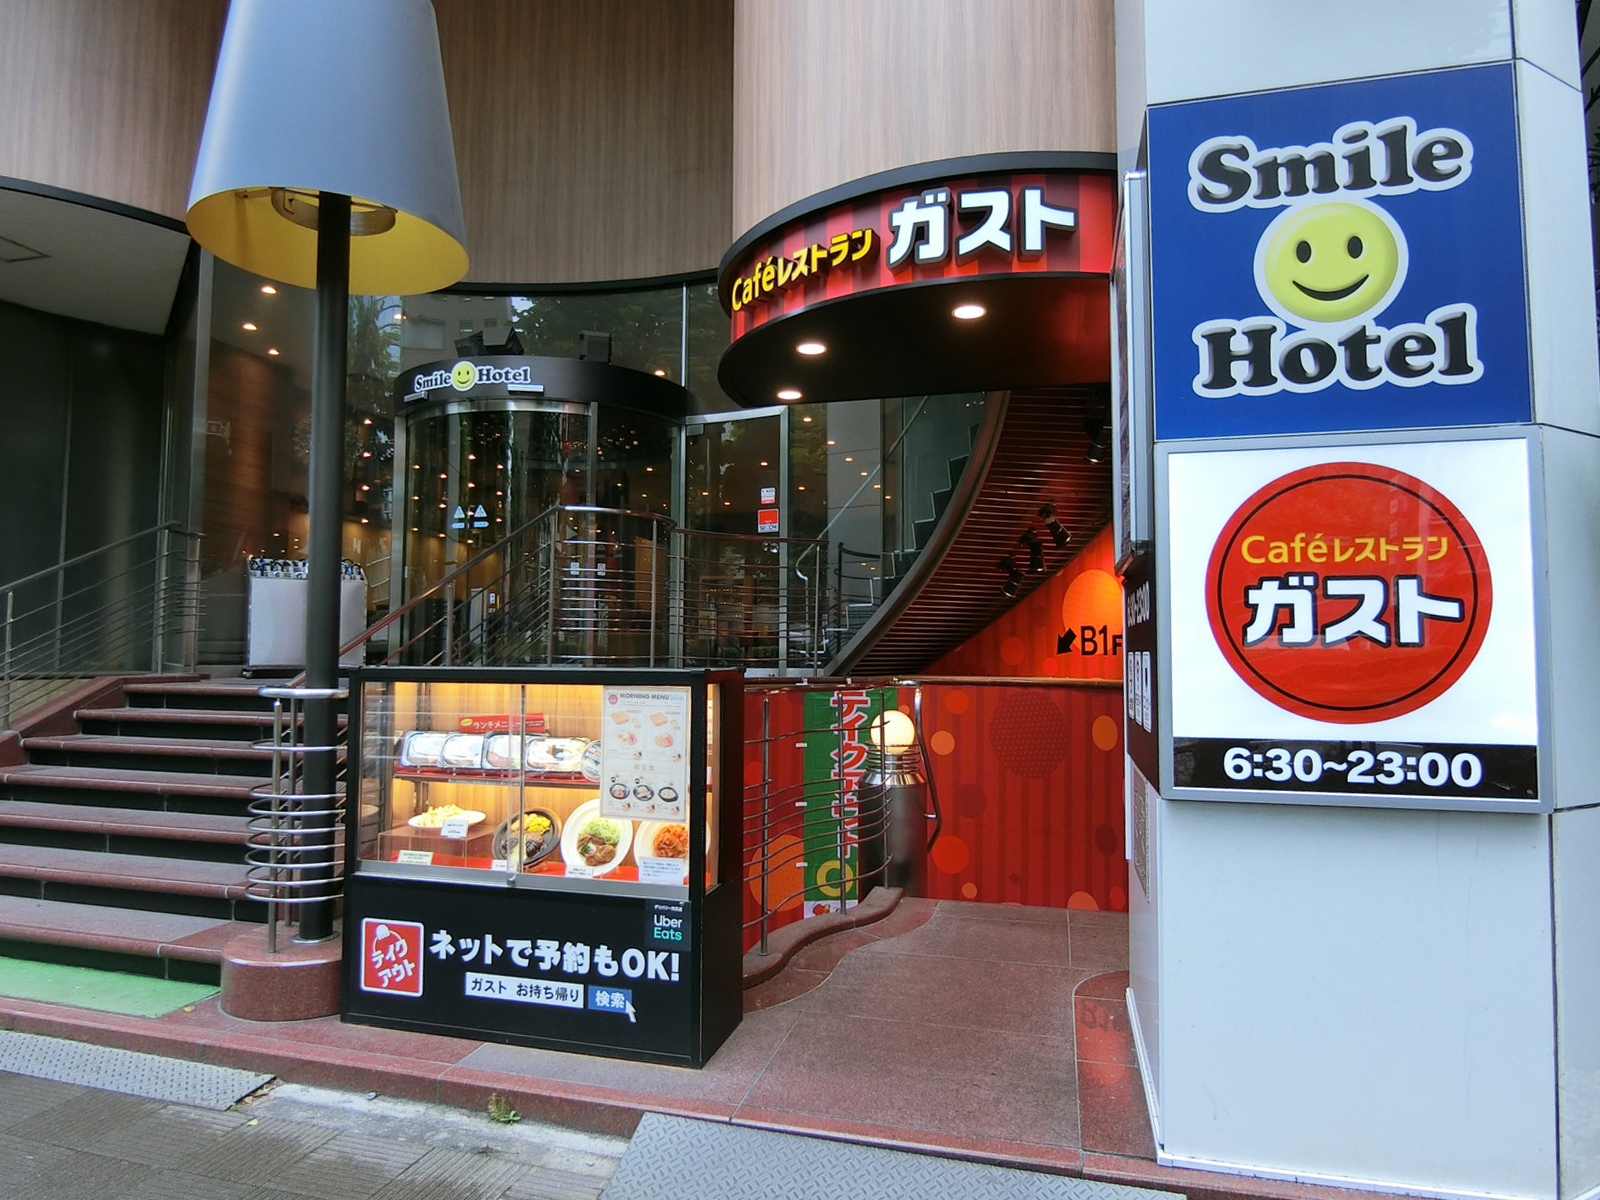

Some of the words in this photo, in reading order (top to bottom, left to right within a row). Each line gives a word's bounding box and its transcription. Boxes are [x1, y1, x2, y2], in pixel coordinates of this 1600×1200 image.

[1195, 122, 1465, 205] Smile
[888, 188, 1076, 267] ガスト
[1199, 310, 1475, 390] Hotel
[415, 372, 450, 392] Smile
[476, 365, 530, 384] Hotel
[1245, 574, 1462, 646] ガスト
[620, 692, 650, 700] MORNING
[1222, 746, 1483, 788] 6:30~23:00
[653, 927, 682, 941] Eats
[654, 914, 683, 928] Uber
[371, 939, 408, 969] テイク
[428, 929, 680, 982] ネットで予約もOK!
[377, 958, 416, 988] アウト
[471, 978, 507, 995] ガスト
[516, 983, 580, 1003] お持ち帰り
[594, 990, 625, 1009] 検索
